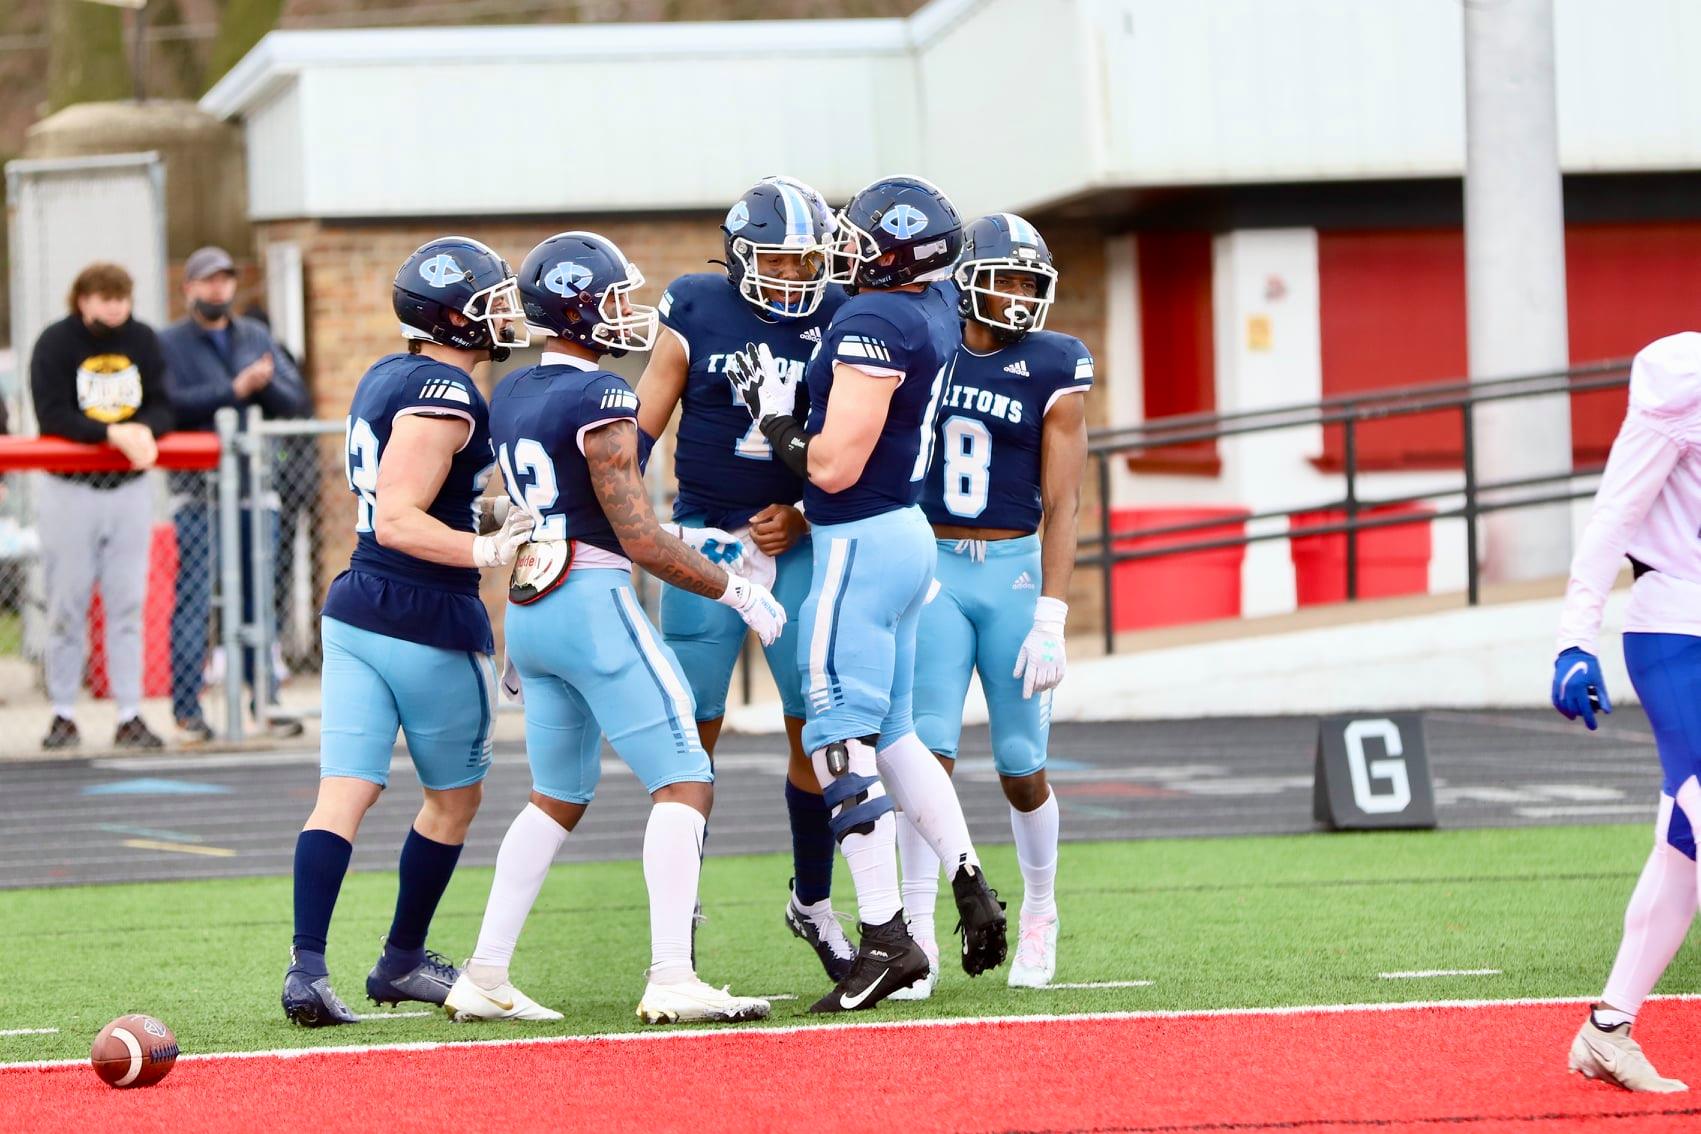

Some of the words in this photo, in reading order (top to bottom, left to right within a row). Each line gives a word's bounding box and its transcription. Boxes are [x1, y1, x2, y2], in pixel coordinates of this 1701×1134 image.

[943, 384, 1024, 425] ITONS
[941, 414, 993, 519] 8
[1343, 718, 1412, 814] G
